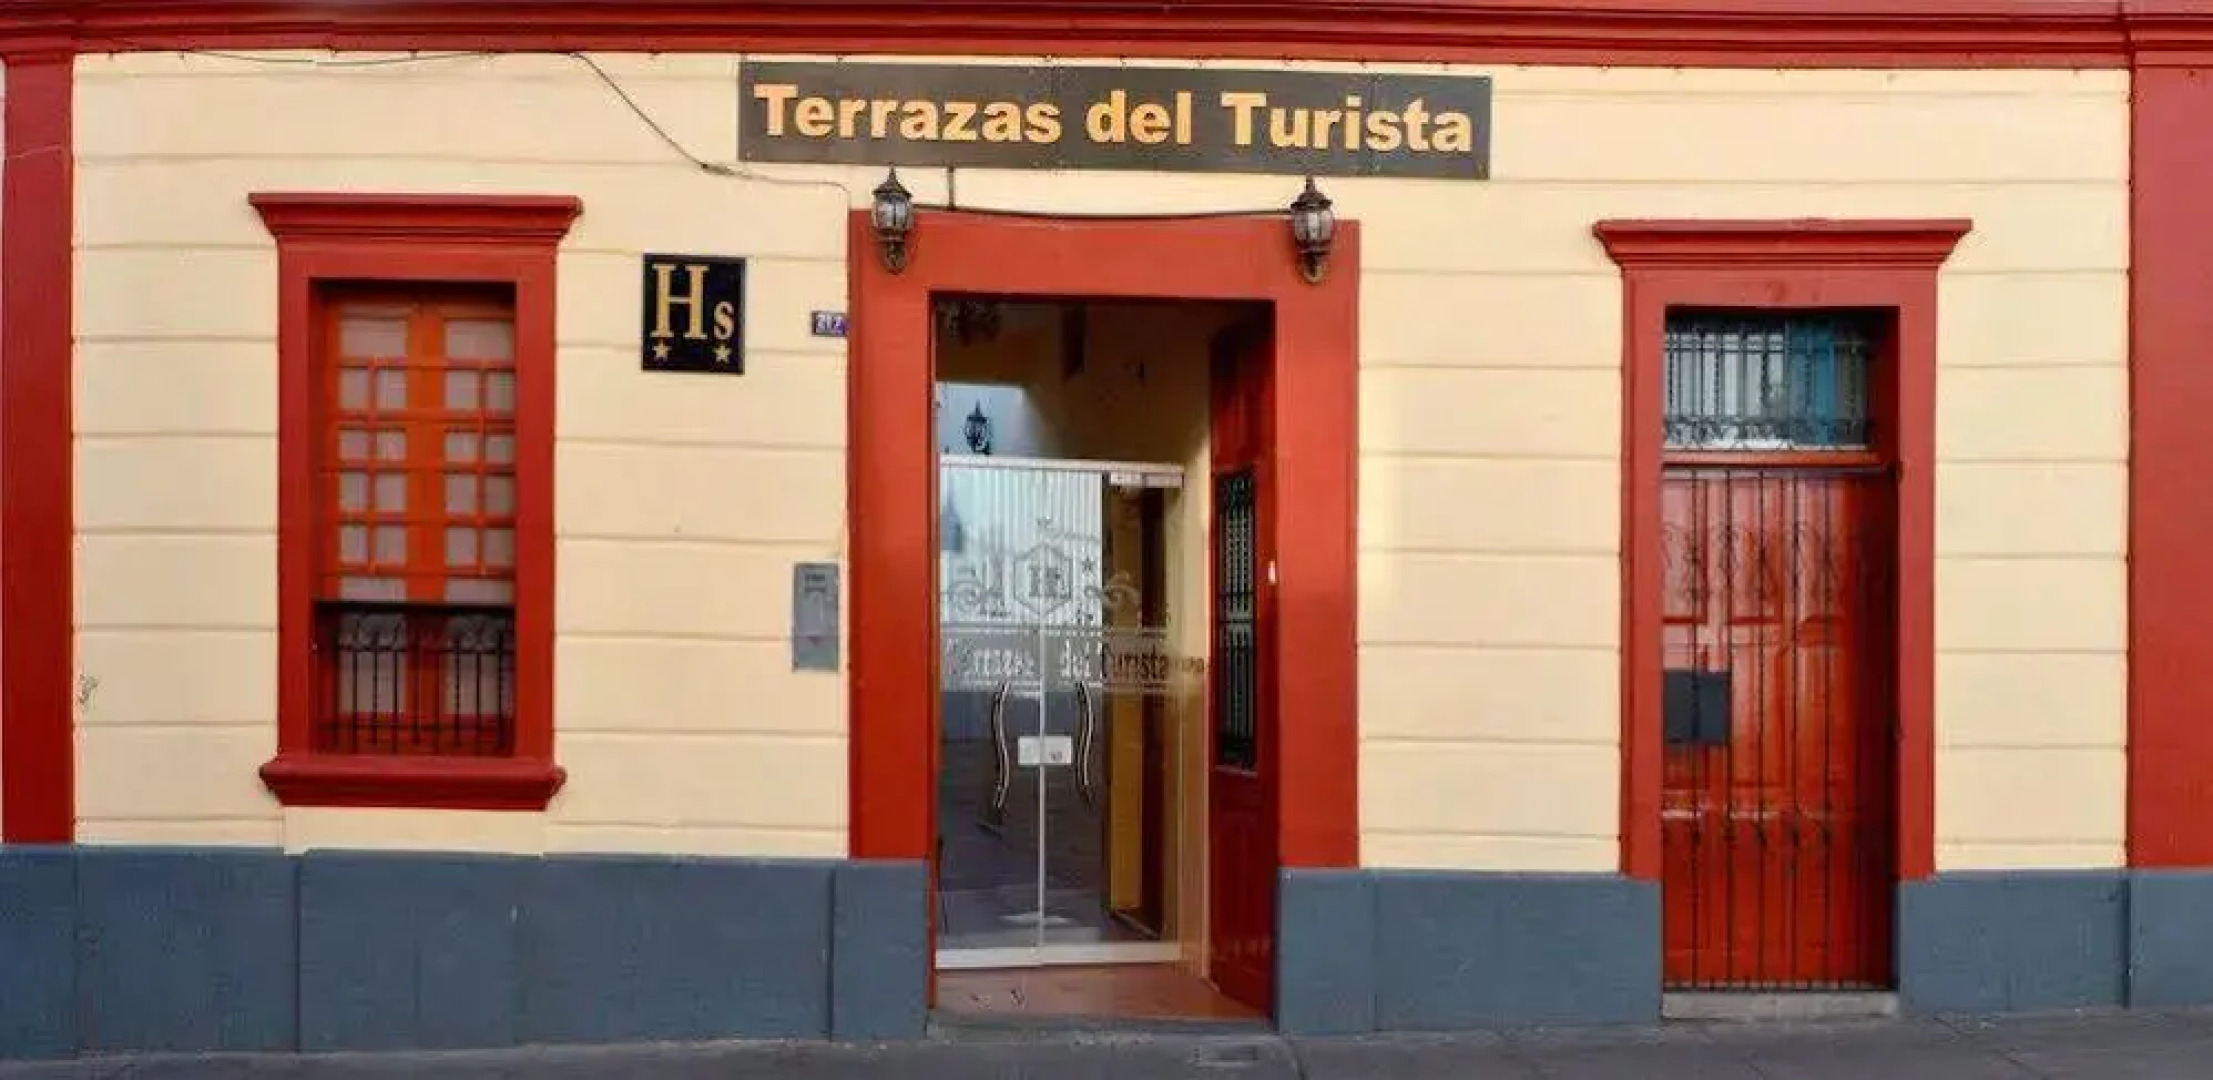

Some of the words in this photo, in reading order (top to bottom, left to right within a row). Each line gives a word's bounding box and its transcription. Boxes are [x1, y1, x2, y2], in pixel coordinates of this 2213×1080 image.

[753, 83, 1063, 144] Terrazas
[1085, 89, 1193, 145] del
[1220, 91, 1473, 153] Turista
